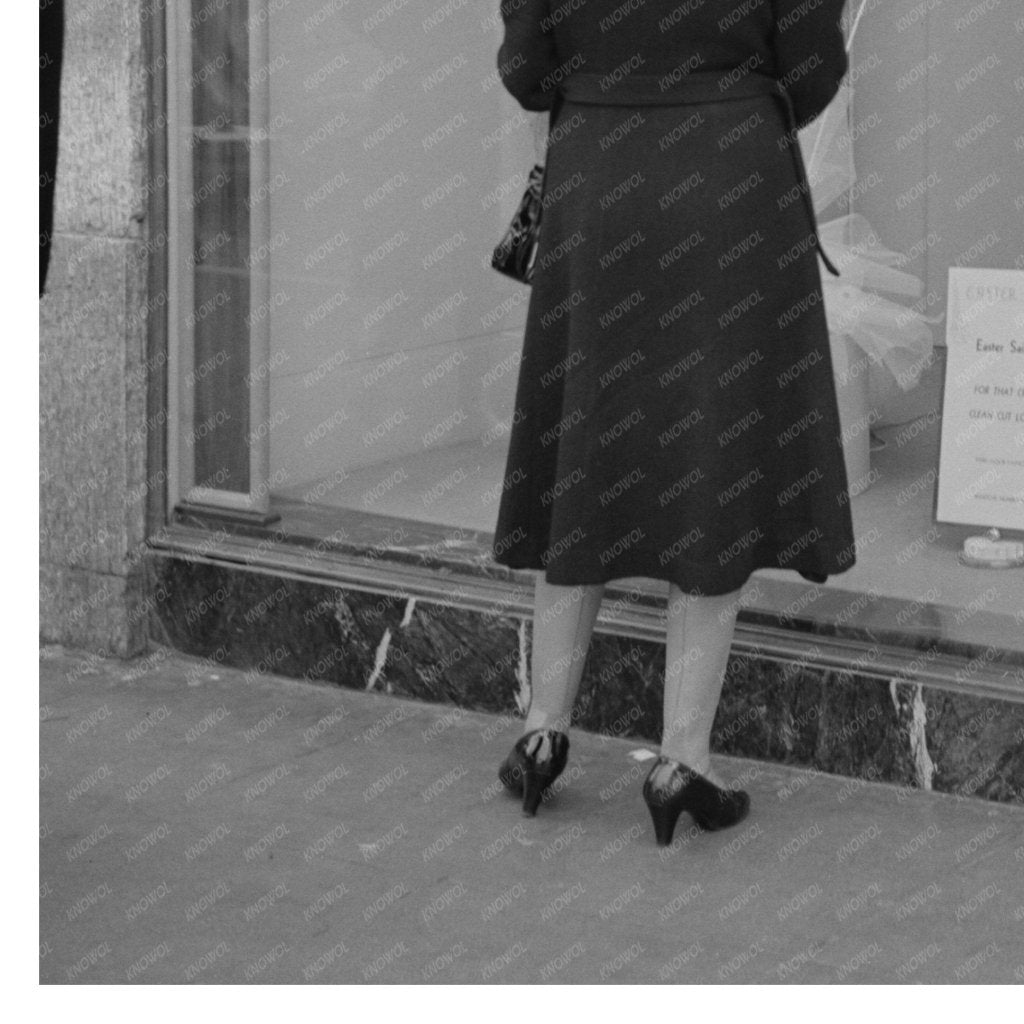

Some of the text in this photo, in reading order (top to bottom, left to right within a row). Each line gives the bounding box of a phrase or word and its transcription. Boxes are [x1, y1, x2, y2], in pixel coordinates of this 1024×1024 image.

[965, 285, 1018, 302] EASTER
[975, 337, 1005, 353] Easter
[973, 385, 990, 395] FOR
[993, 386, 1014, 397] THAT
[968, 408, 995, 420] CLEAN
[996, 410, 1012, 421] CUT
